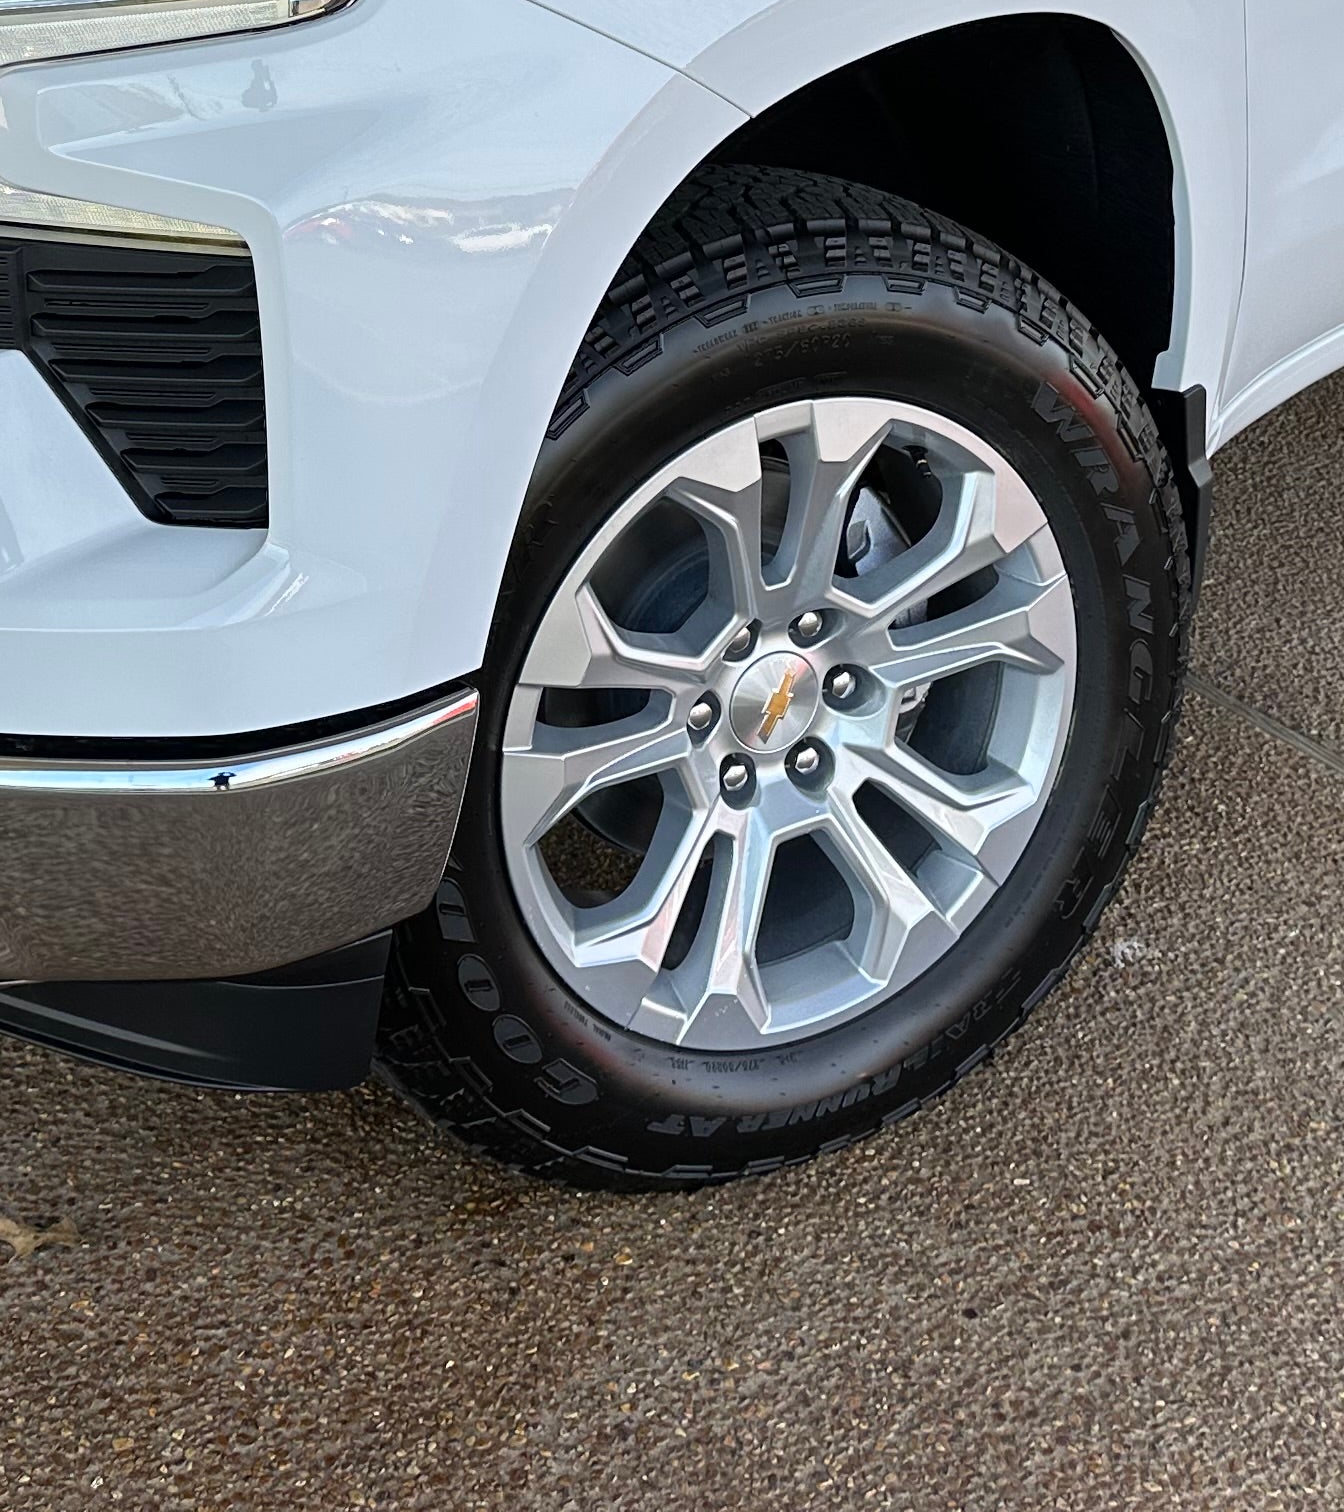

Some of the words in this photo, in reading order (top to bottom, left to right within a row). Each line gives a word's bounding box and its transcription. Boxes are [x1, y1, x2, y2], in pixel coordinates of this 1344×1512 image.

[1031, 381, 1155, 919] WRANGLER
[437, 852, 598, 1105] GOOD
[647, 1113, 724, 1138] AT
